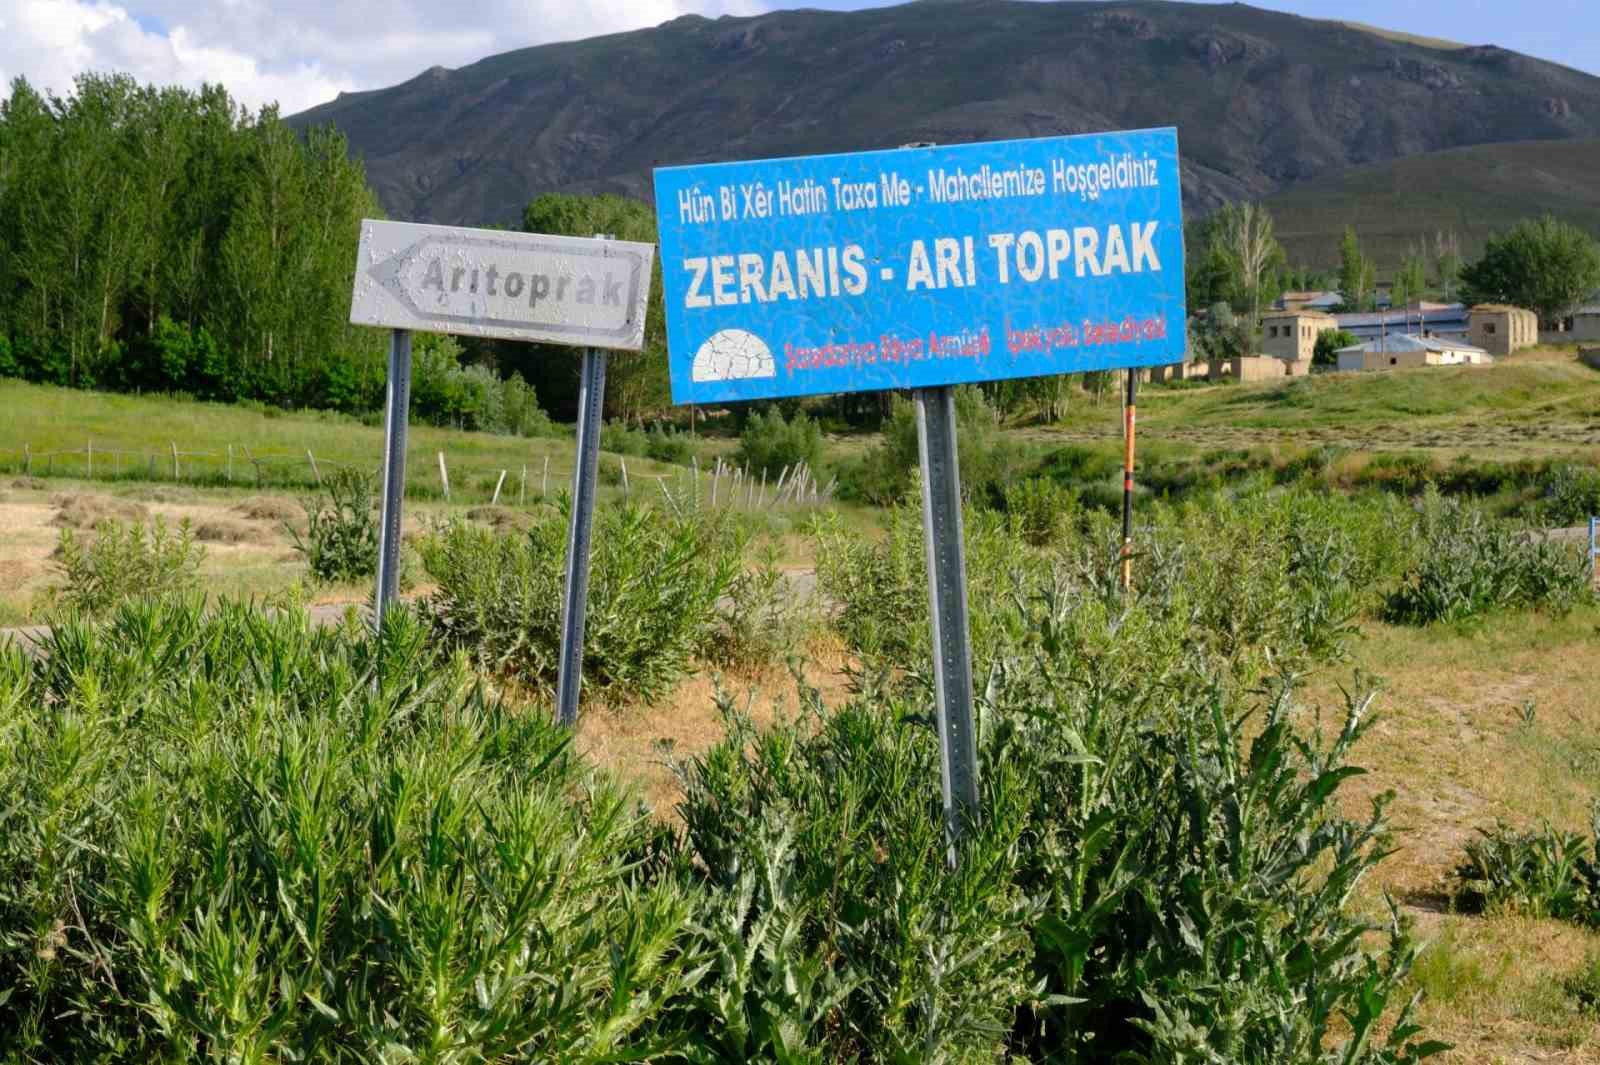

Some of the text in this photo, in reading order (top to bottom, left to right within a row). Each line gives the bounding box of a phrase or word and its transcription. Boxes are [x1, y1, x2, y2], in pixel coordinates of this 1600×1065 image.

[678, 186, 716, 224] Hûn
[720, 184, 736, 220] Bi
[742, 181, 774, 218] Xêr
[778, 179, 828, 215] Hatin
[832, 177, 877, 210] Taxa
[880, 172, 911, 206] Me
[1052, 153, 1159, 201] Hoşgeldiniz
[683, 220, 1161, 308] ZERANIS - ARI TOPRAK
